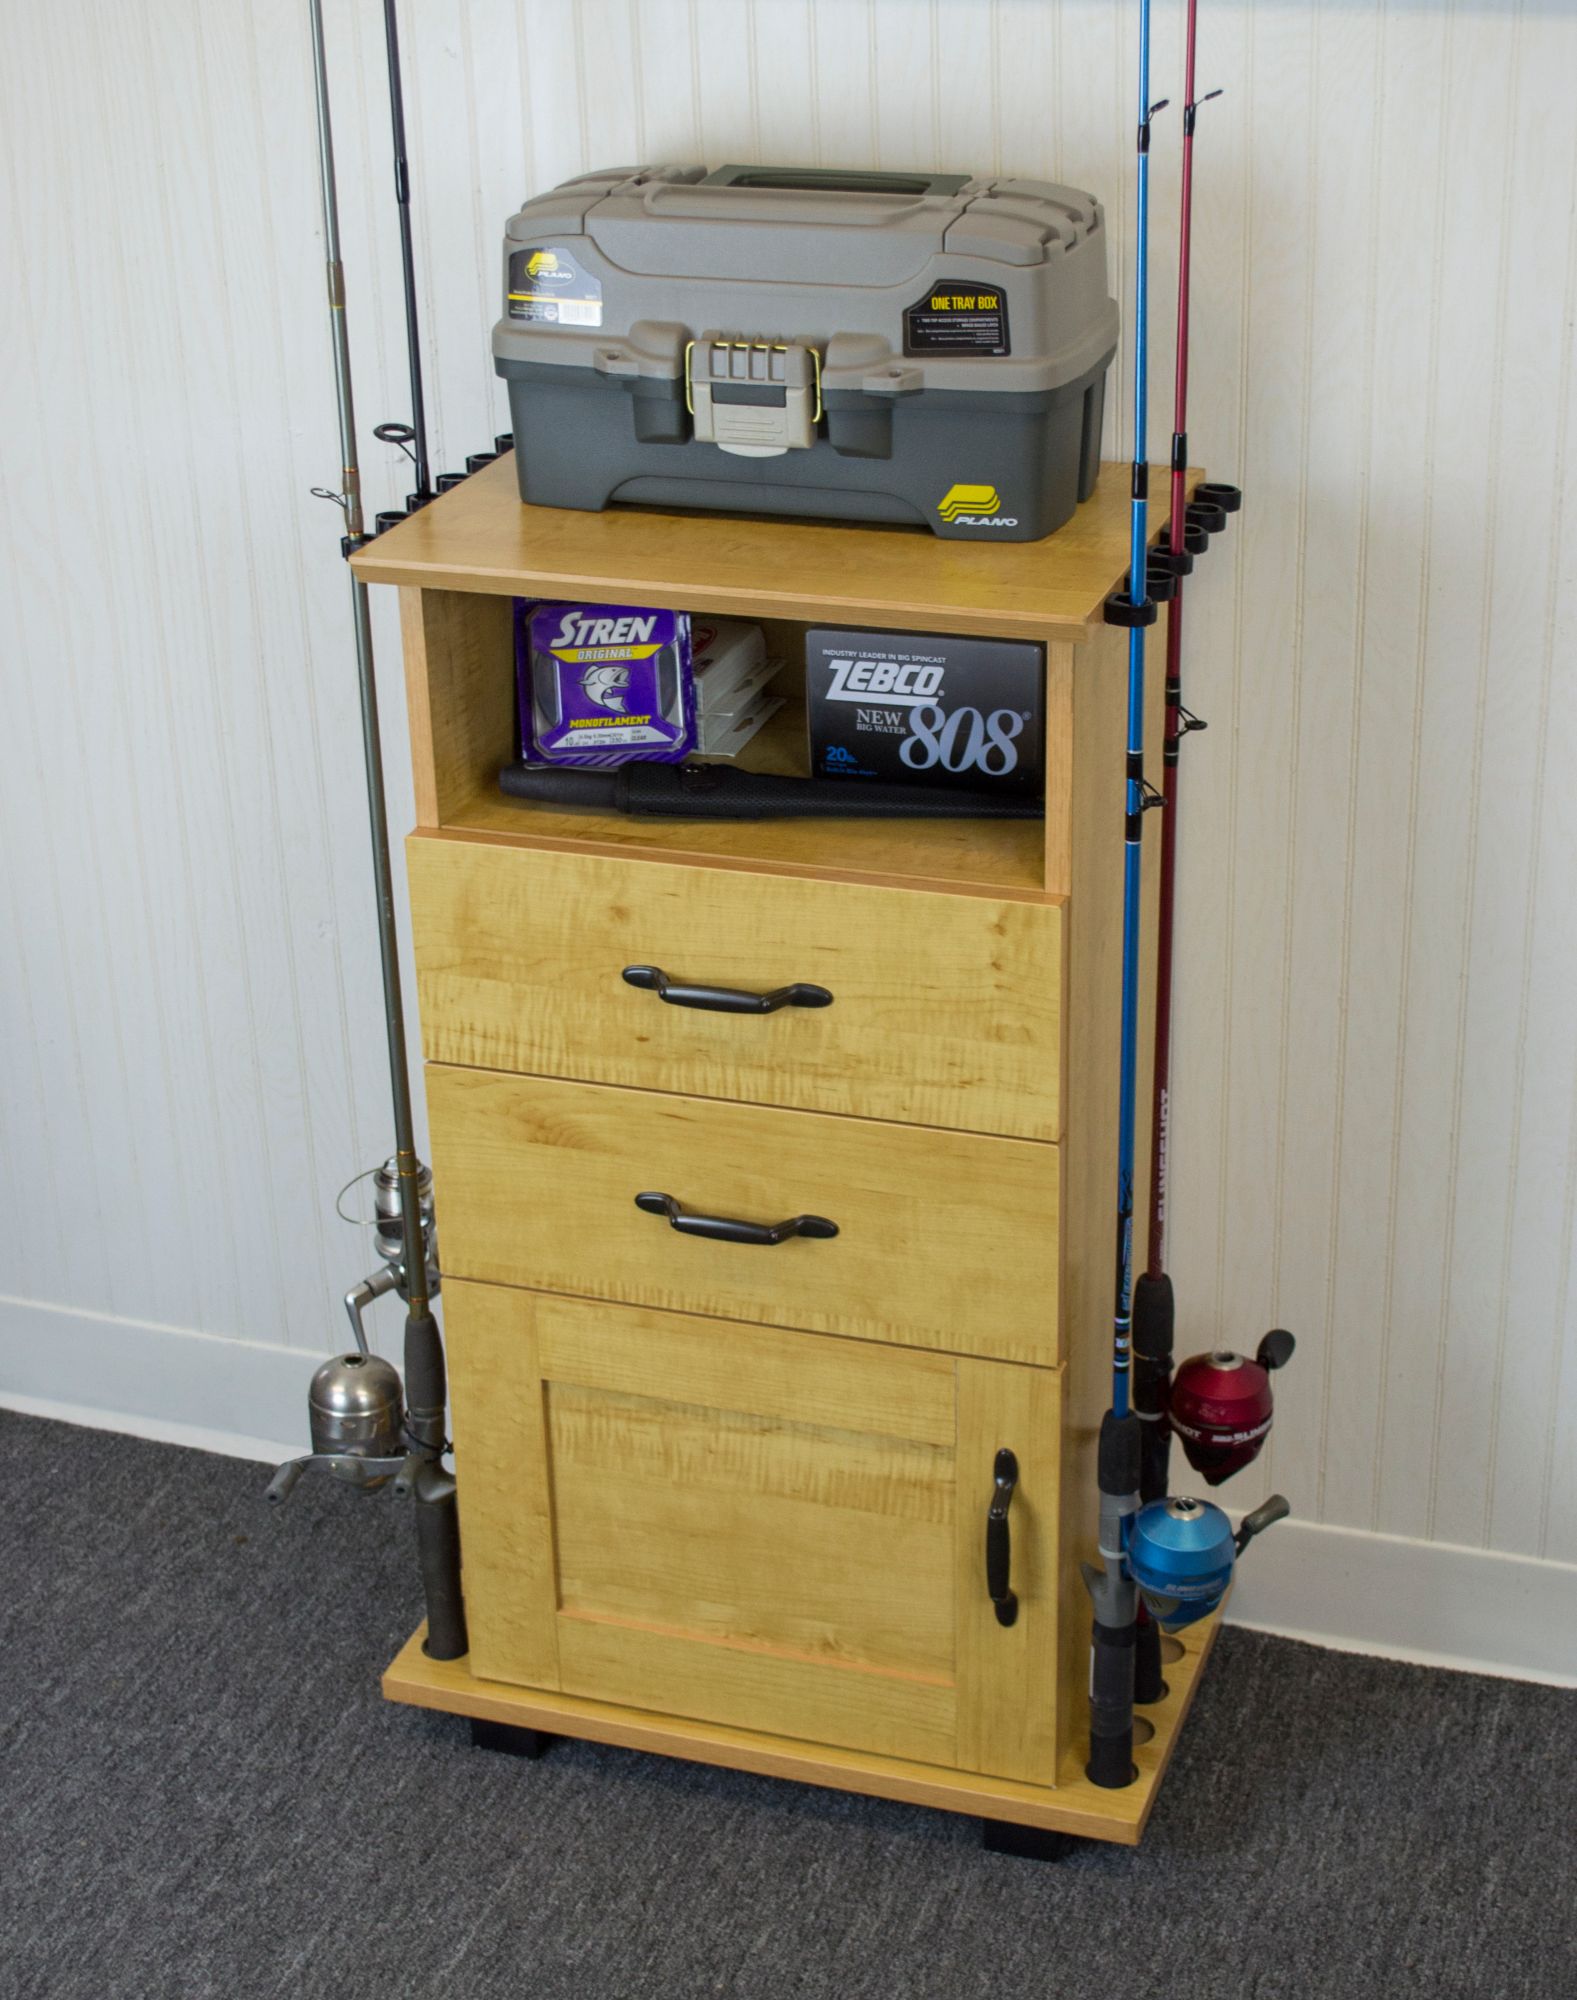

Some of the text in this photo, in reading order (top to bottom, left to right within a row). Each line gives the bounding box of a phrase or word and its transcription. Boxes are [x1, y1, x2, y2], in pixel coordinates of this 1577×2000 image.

[931, 296, 999, 310] ONE TRAY BOX
[954, 516, 1018, 527] PLANO
[550, 611, 657, 647] STREN
[577, 648, 633, 660] ORIGINAL
[822, 649, 857, 658] INDUSTRY
[859, 651, 887, 660] LEADER
[911, 655, 946, 663] SPINCAST
[825, 659, 945, 707] ZEBCO
[569, 715, 651, 728] MONOFILAMENT
[856, 708, 903, 726] NEW
[856, 723, 906, 735] BIG WATER
